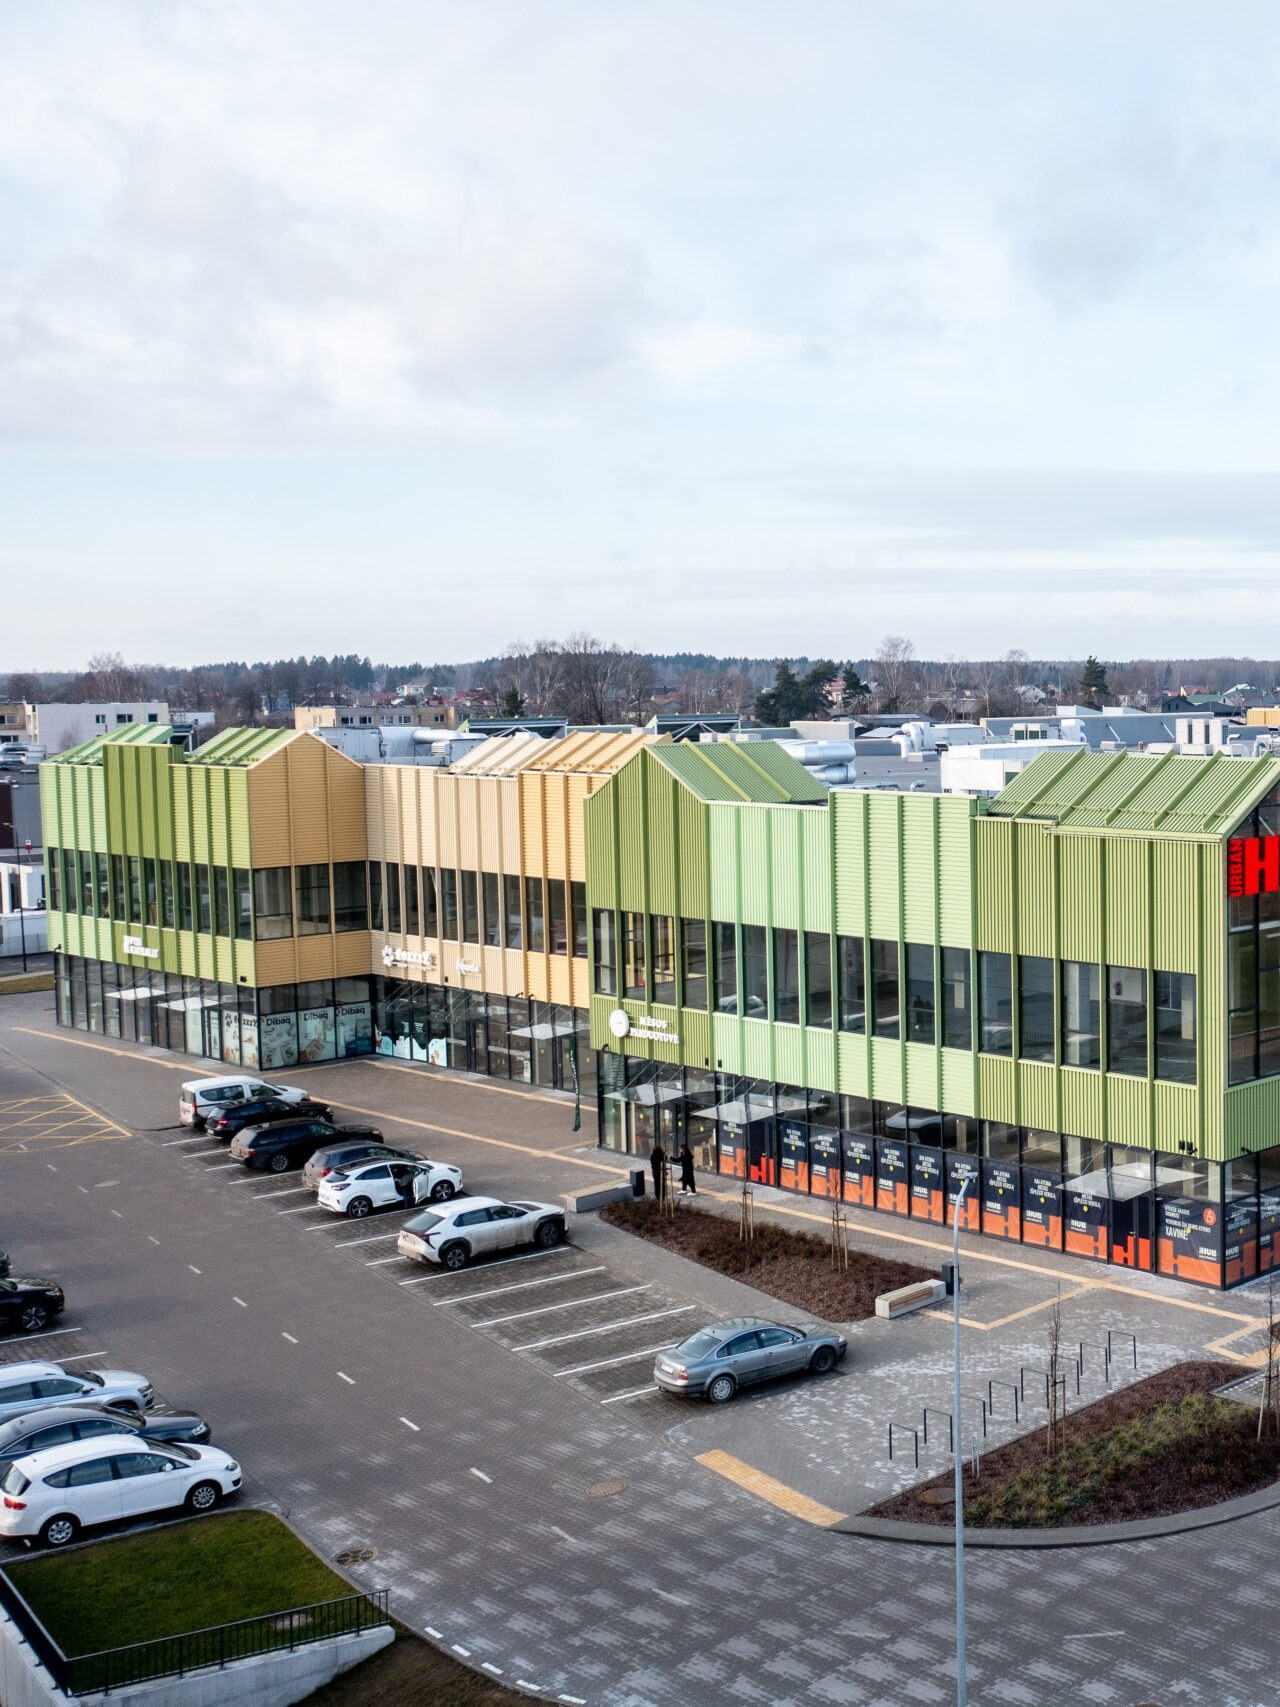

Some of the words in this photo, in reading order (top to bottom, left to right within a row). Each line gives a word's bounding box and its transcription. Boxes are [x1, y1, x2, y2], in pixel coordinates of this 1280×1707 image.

[1228, 839, 1244, 897] URBAN
[342, 1007, 365, 1016] Dibaq
[266, 1016, 291, 1026] Dibaq
[304, 1012, 328, 1021] Dibaq
